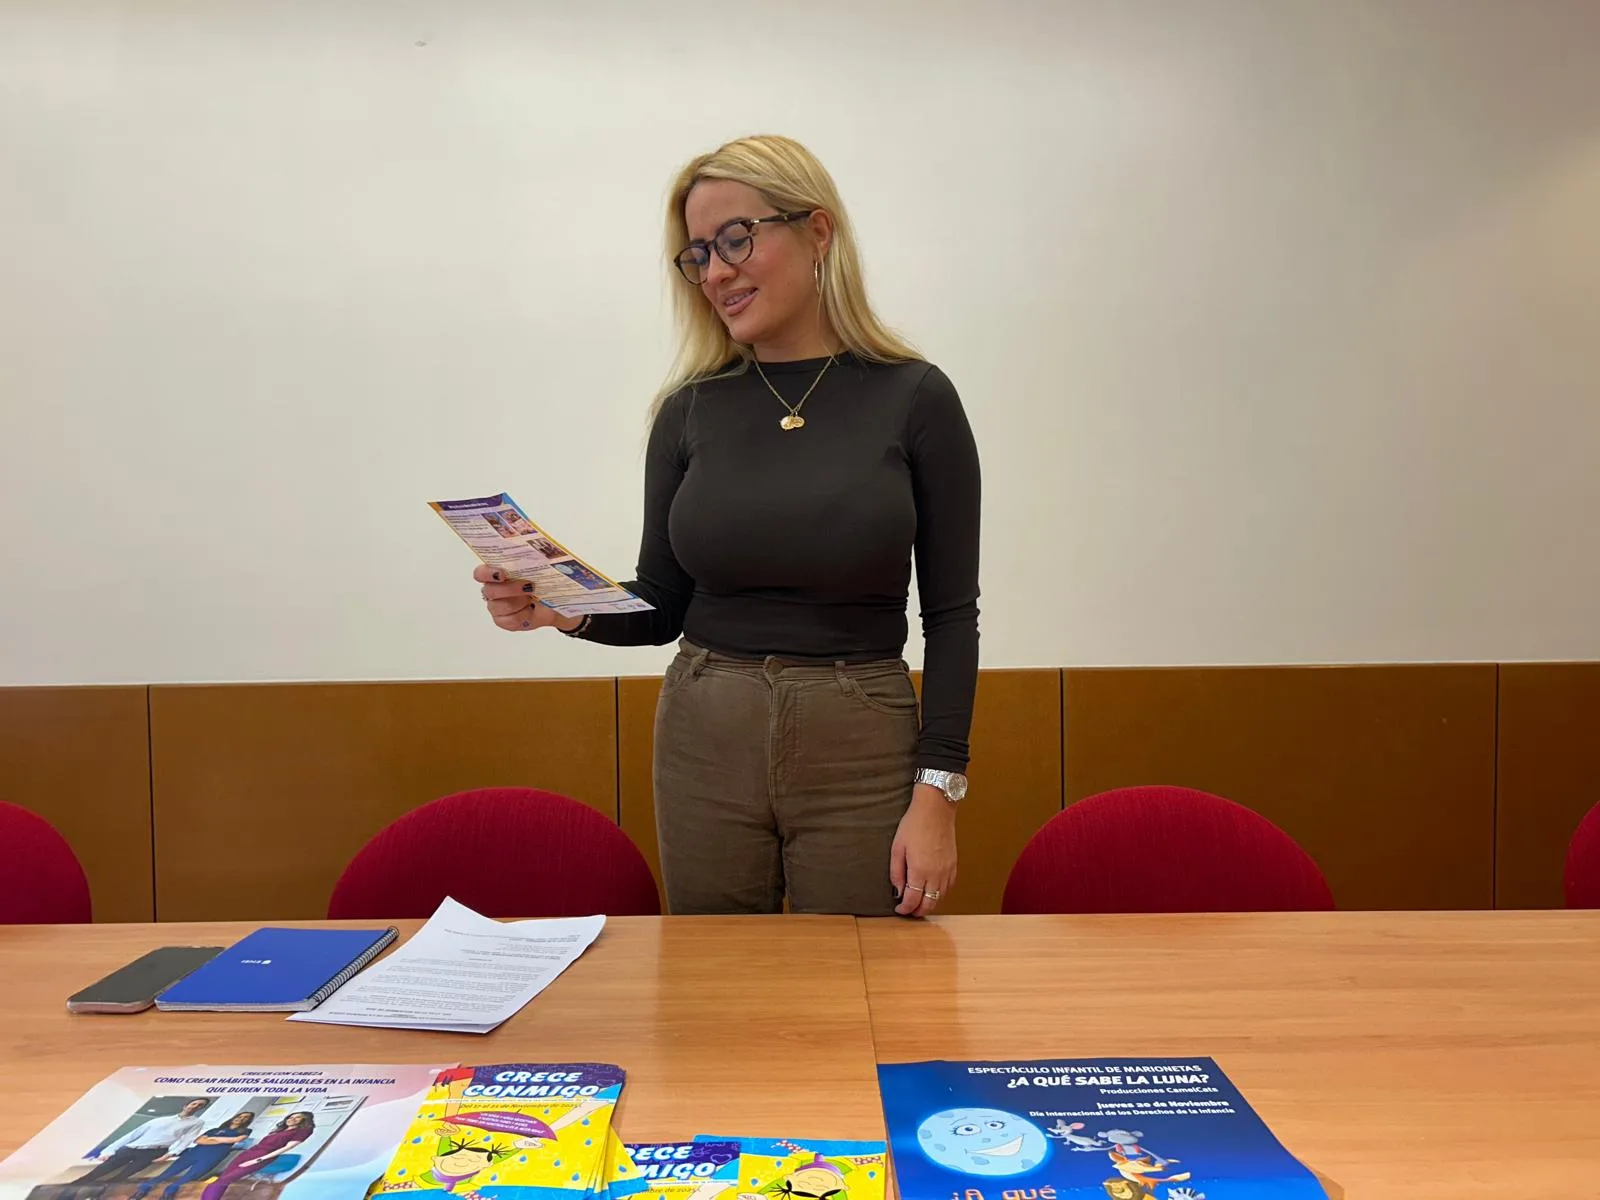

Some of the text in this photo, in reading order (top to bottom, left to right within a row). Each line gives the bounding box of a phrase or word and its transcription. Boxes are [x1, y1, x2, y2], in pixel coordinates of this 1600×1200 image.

[968, 1066, 1050, 1074] ESPECTÁCULO
[1052, 1066, 1104, 1074] INFANTIL
[1123, 1065, 1203, 1073] MARIONETAS
[216, 1076, 261, 1084] HÁBITOS
[260, 1077, 325, 1085] SALUDABLES
[494, 1071, 584, 1083] CRECE
[1007, 1074, 1210, 1088] ¿A QUÉ SABE LA LUNA?
[205, 1086, 228, 1094] QUE
[226, 1086, 262, 1094] DUREN
[263, 1086, 290, 1094] TODA
[463, 1085, 600, 1098] CONMIGO
[1096, 1102, 1135, 1110] Jueves
[1168, 1100, 1230, 1108] Noviembre
[623, 1146, 694, 1161] ECE
[636, 1162, 717, 1180] MIGO
